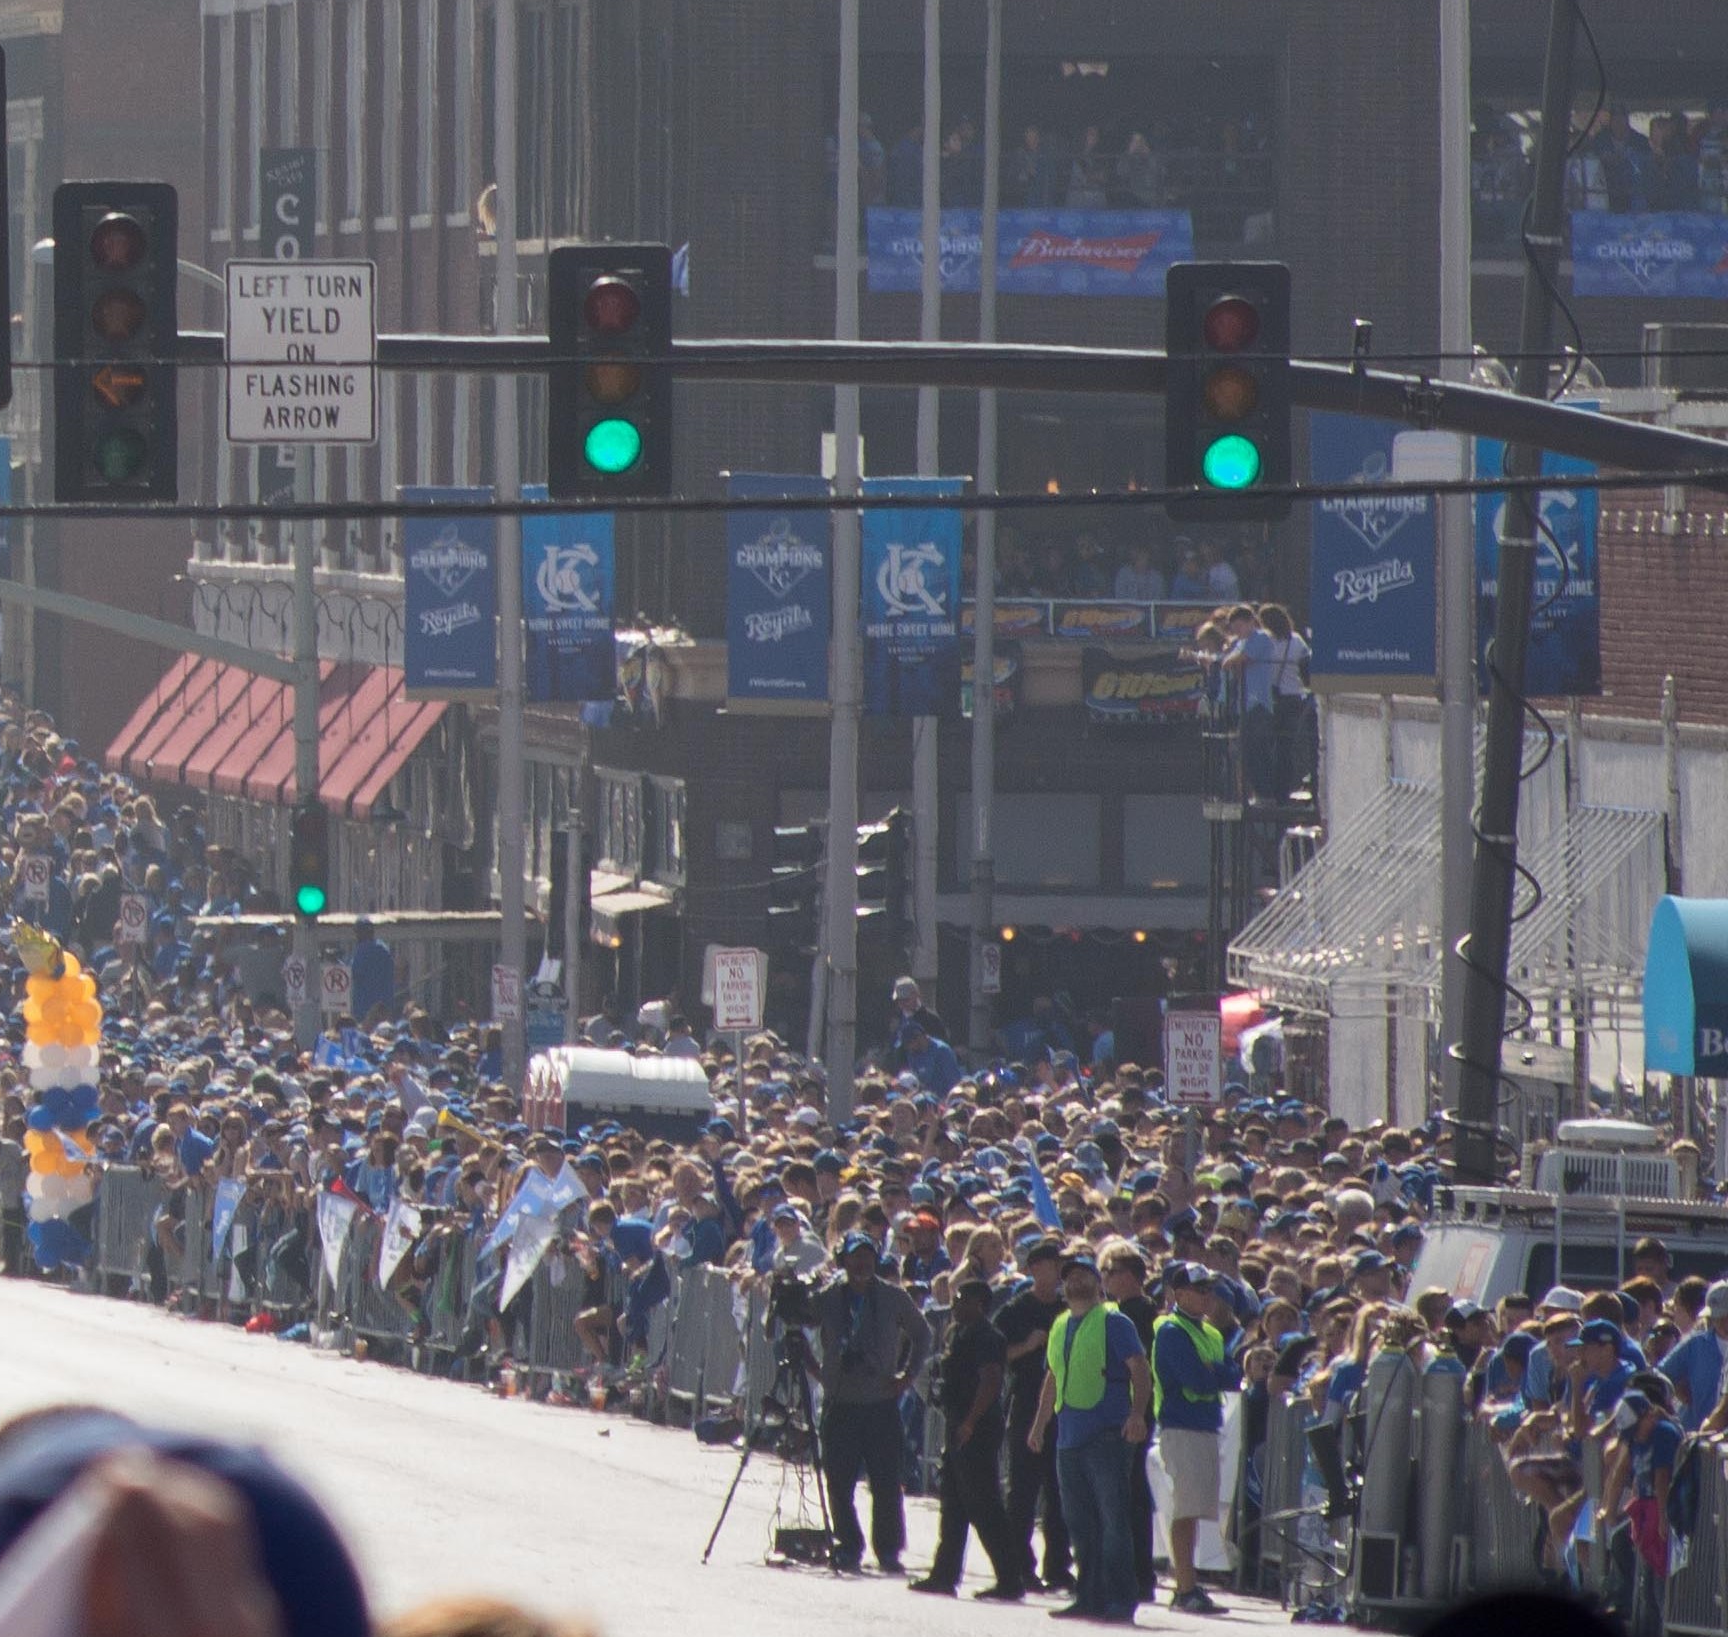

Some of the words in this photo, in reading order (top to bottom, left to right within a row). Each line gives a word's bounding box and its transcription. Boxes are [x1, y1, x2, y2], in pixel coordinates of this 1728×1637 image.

[238, 275, 290, 298] LEFT
[304, 275, 362, 298] TURN
[261, 307, 341, 334] YIELD
[286, 343, 316, 363] ON
[246, 373, 355, 397] FLASHING
[262, 406, 341, 430] ARROW
[1321, 495, 1428, 513] CHAMPIONS
[410, 551, 489, 570] CHAMPIONS
[736, 548, 825, 570] CHAMPIONS
[1334, 557, 1416, 605] Royals
[419, 602, 482, 637] Royals
[556, 617, 583, 631] SWEET
[744, 604, 813, 642] Royals
[866, 622, 894, 638] HOME
[895, 622, 928, 638] SWEET
[1337, 649, 1411, 661] #WorldSeries
[729, 966, 744, 979] NO
[1184, 1032, 1204, 1047] NO
[1174, 1047, 1214, 1061] PARKING
[1180, 1076, 1209, 1088] NIGHT
